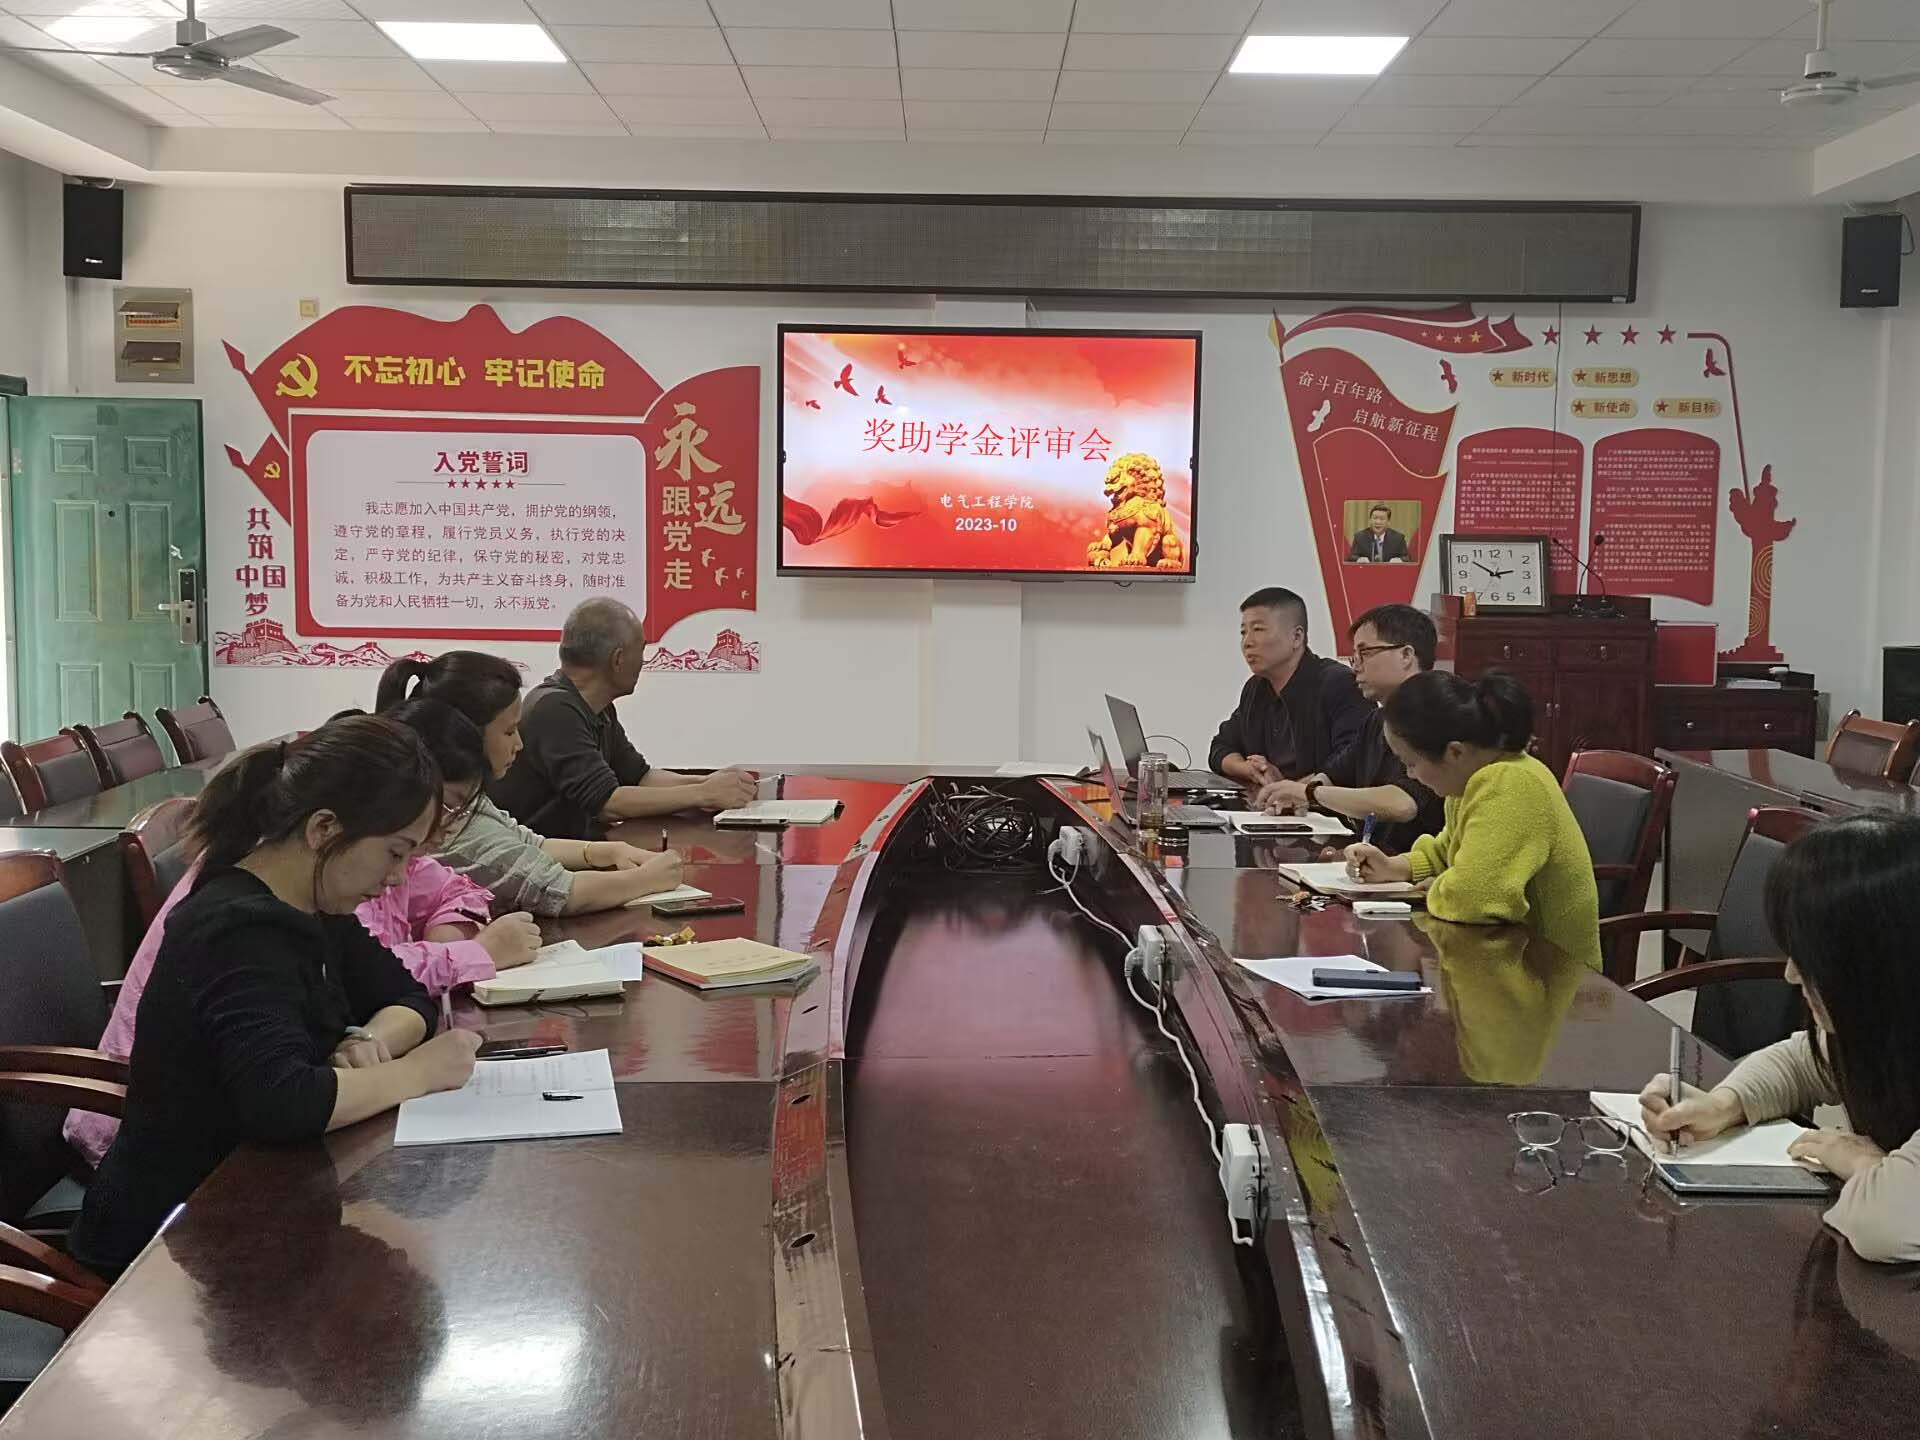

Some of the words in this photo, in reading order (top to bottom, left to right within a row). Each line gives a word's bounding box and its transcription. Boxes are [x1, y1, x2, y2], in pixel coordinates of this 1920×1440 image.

[344, 355, 466, 387] 不忘初心
[484, 358, 605, 390] 牢记使命
[1511, 370, 1550, 384] 新时代
[1594, 371, 1632, 384] 新思想
[1298, 370, 1383, 405] 奋斗百年路
[1593, 401, 1631, 414] 新使命
[1678, 401, 1716, 414] 新目标
[1352, 408, 1440, 442] 启航新征程
[862, 416, 1113, 463] 奖助学金评审会
[433, 450, 529, 474] 入党誓词
[654, 401, 747, 536] 永远
[940, 493, 1035, 510] 电气工程学院
[955, 517, 1018, 532] 2023-10
[662, 485, 693, 590] 跟党走
[1456, 555, 1469, 563] 10
[1473, 549, 1483, 559] 11
[1488, 549, 1500, 559] 12
[1521, 555, 1530, 565] 2
[1458, 570, 1468, 579] 9
[1522, 571, 1531, 580] 3
[1490, 592, 1500, 601] 6
[1506, 592, 1515, 601] 5
[1522, 586, 1531, 595] 4
